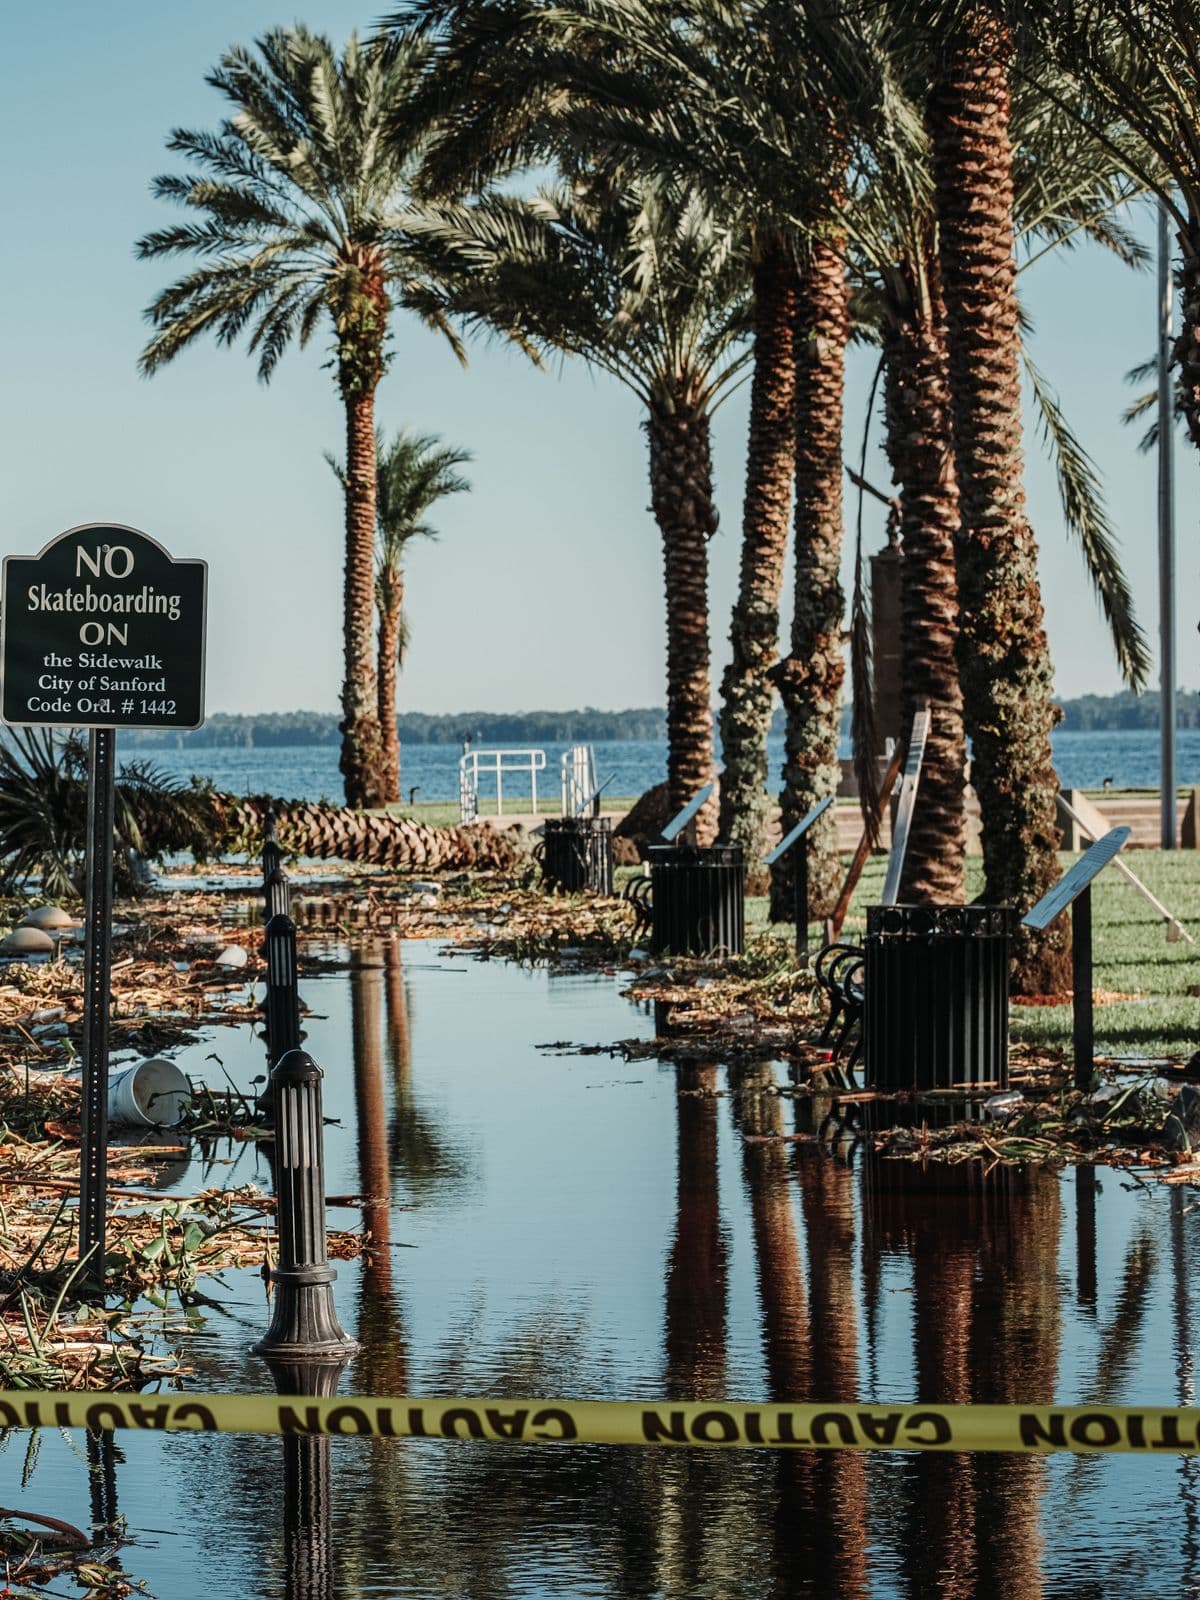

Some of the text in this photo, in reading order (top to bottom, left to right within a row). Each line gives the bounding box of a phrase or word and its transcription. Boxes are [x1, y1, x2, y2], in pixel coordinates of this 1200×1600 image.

[76, 544, 134, 578] NO
[28, 584, 180, 620] Skateboarding
[80, 622, 128, 645] ON
[44, 653, 162, 669] the Sidewalk
[39, 675, 165, 694] City of Sanford
[27, 697, 176, 714] Code Ord. # 1442
[278, 1405, 578, 1439] CAUTION
[641, 1410, 952, 1445] CAUTION
[1018, 1413, 1200, 1448] TION
